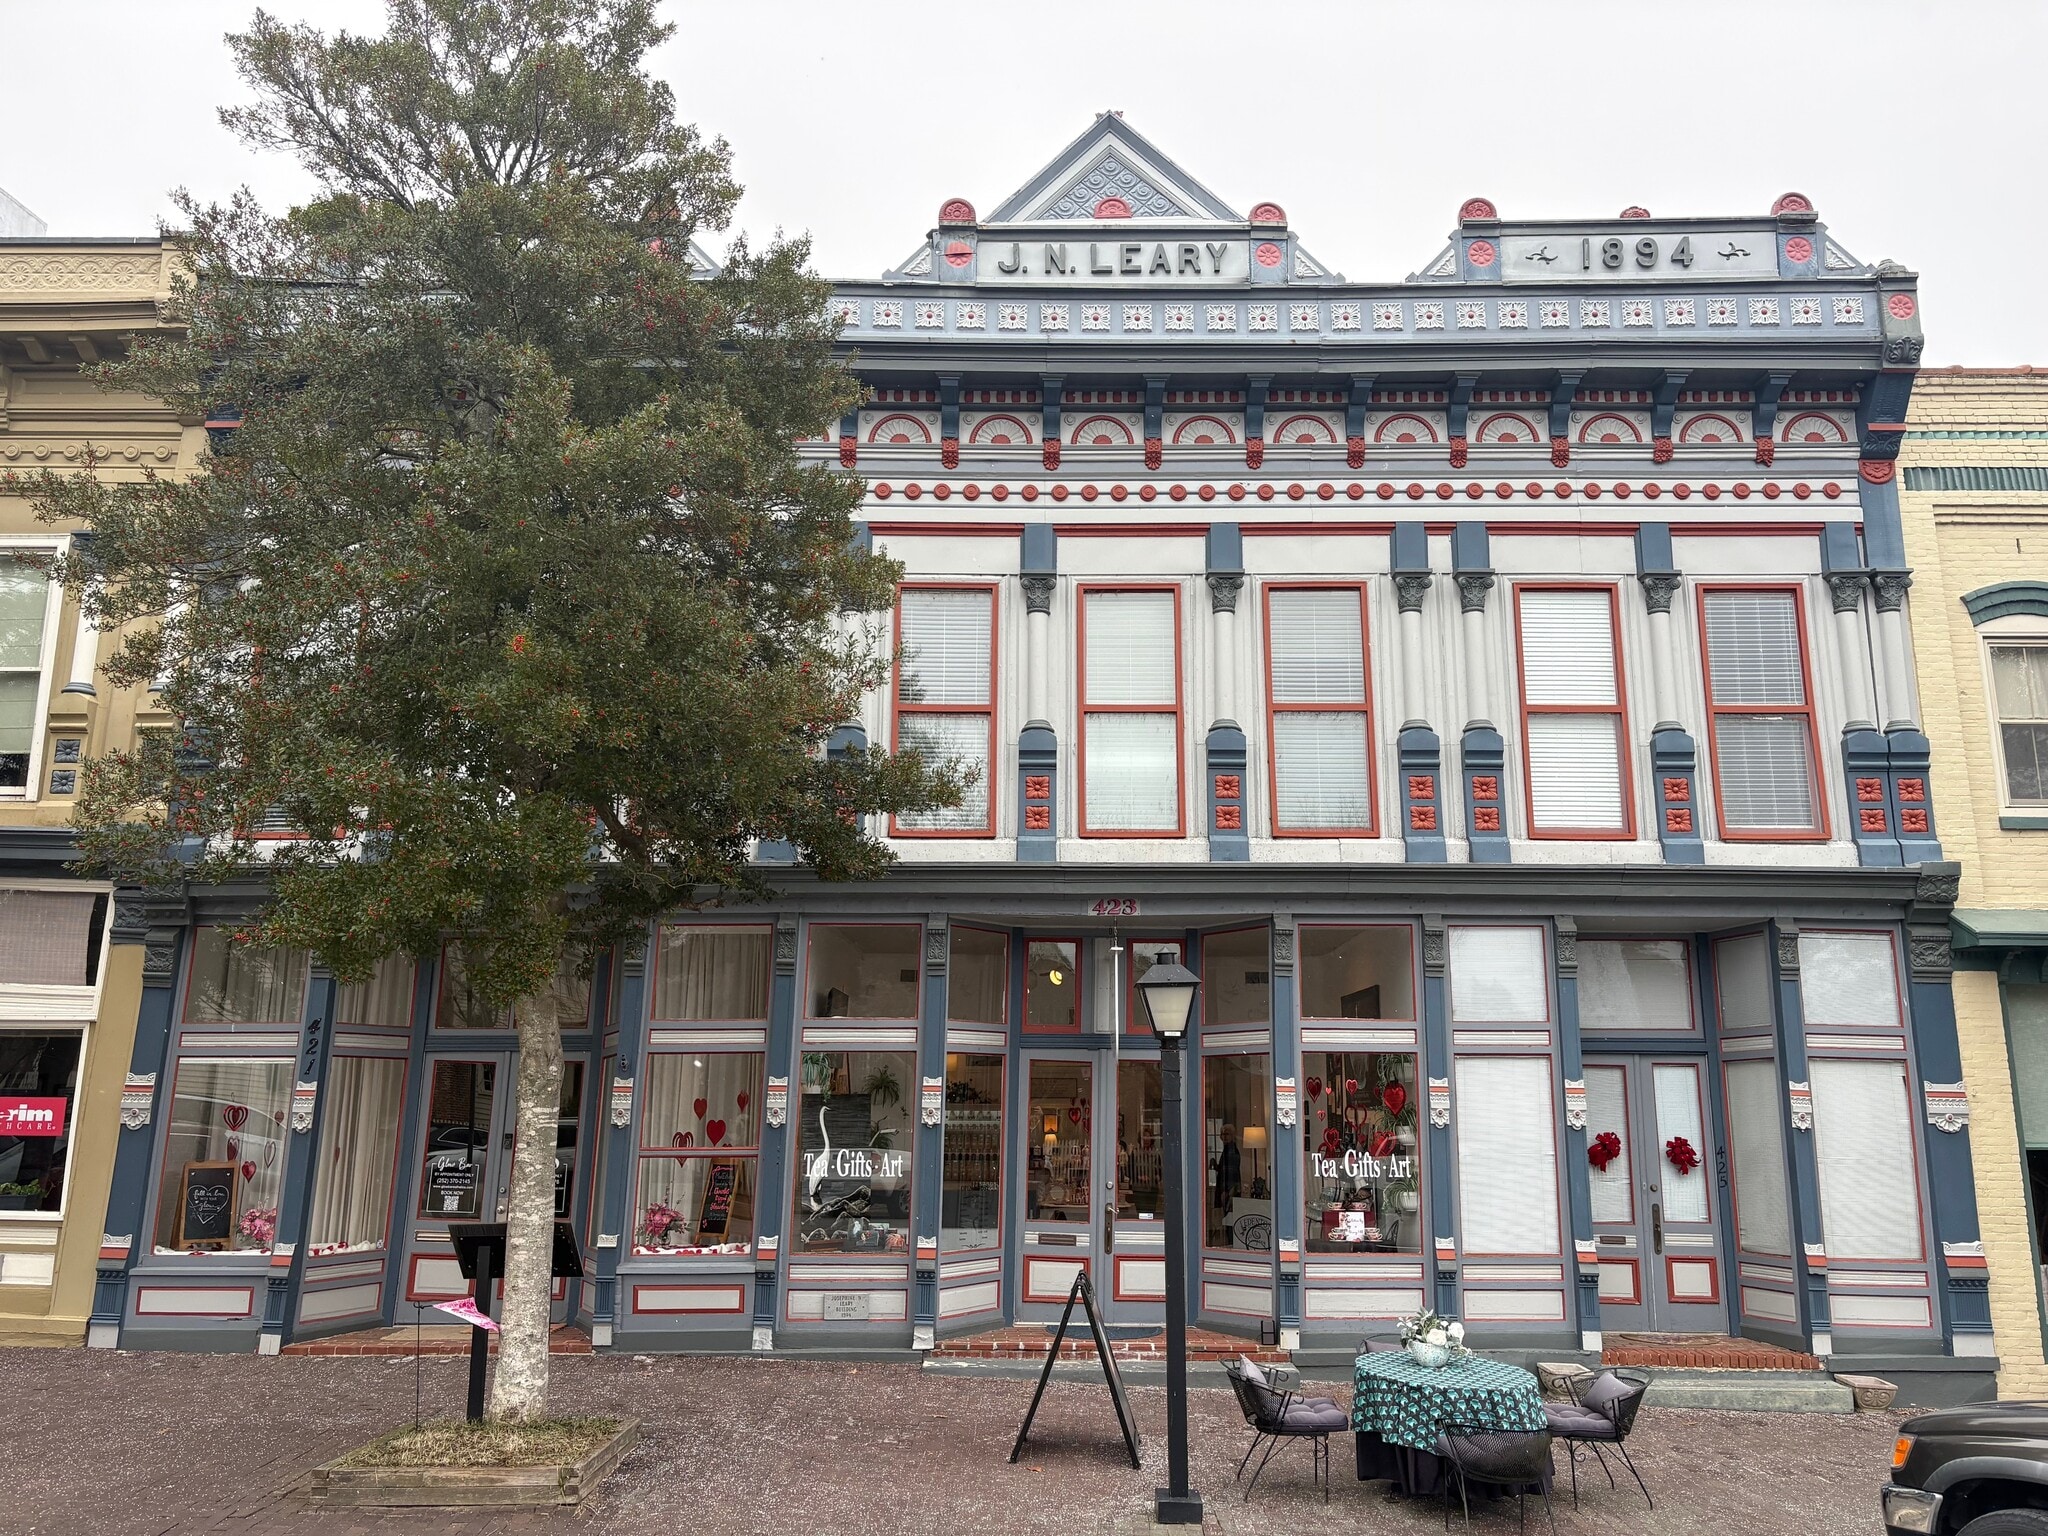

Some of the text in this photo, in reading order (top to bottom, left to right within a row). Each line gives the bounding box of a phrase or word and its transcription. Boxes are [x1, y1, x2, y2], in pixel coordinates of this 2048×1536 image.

[998, 243, 1228, 274] J. N. LEARY
[1582, 236, 1695, 270] 1894
[1092, 899, 1137, 916] 423
[304, 1017, 322, 1076] 421
[0, 1103, 53, 1121] rim
[0, 1122, 52, 1130] HCARE
[437, 1156, 473, 1171] Glow Bar
[804, 1149, 903, 1178] Tea Gifts Art
[1312, 1149, 1412, 1178] Tea Gifts Art
[1716, 1146, 1728, 1188] 425
